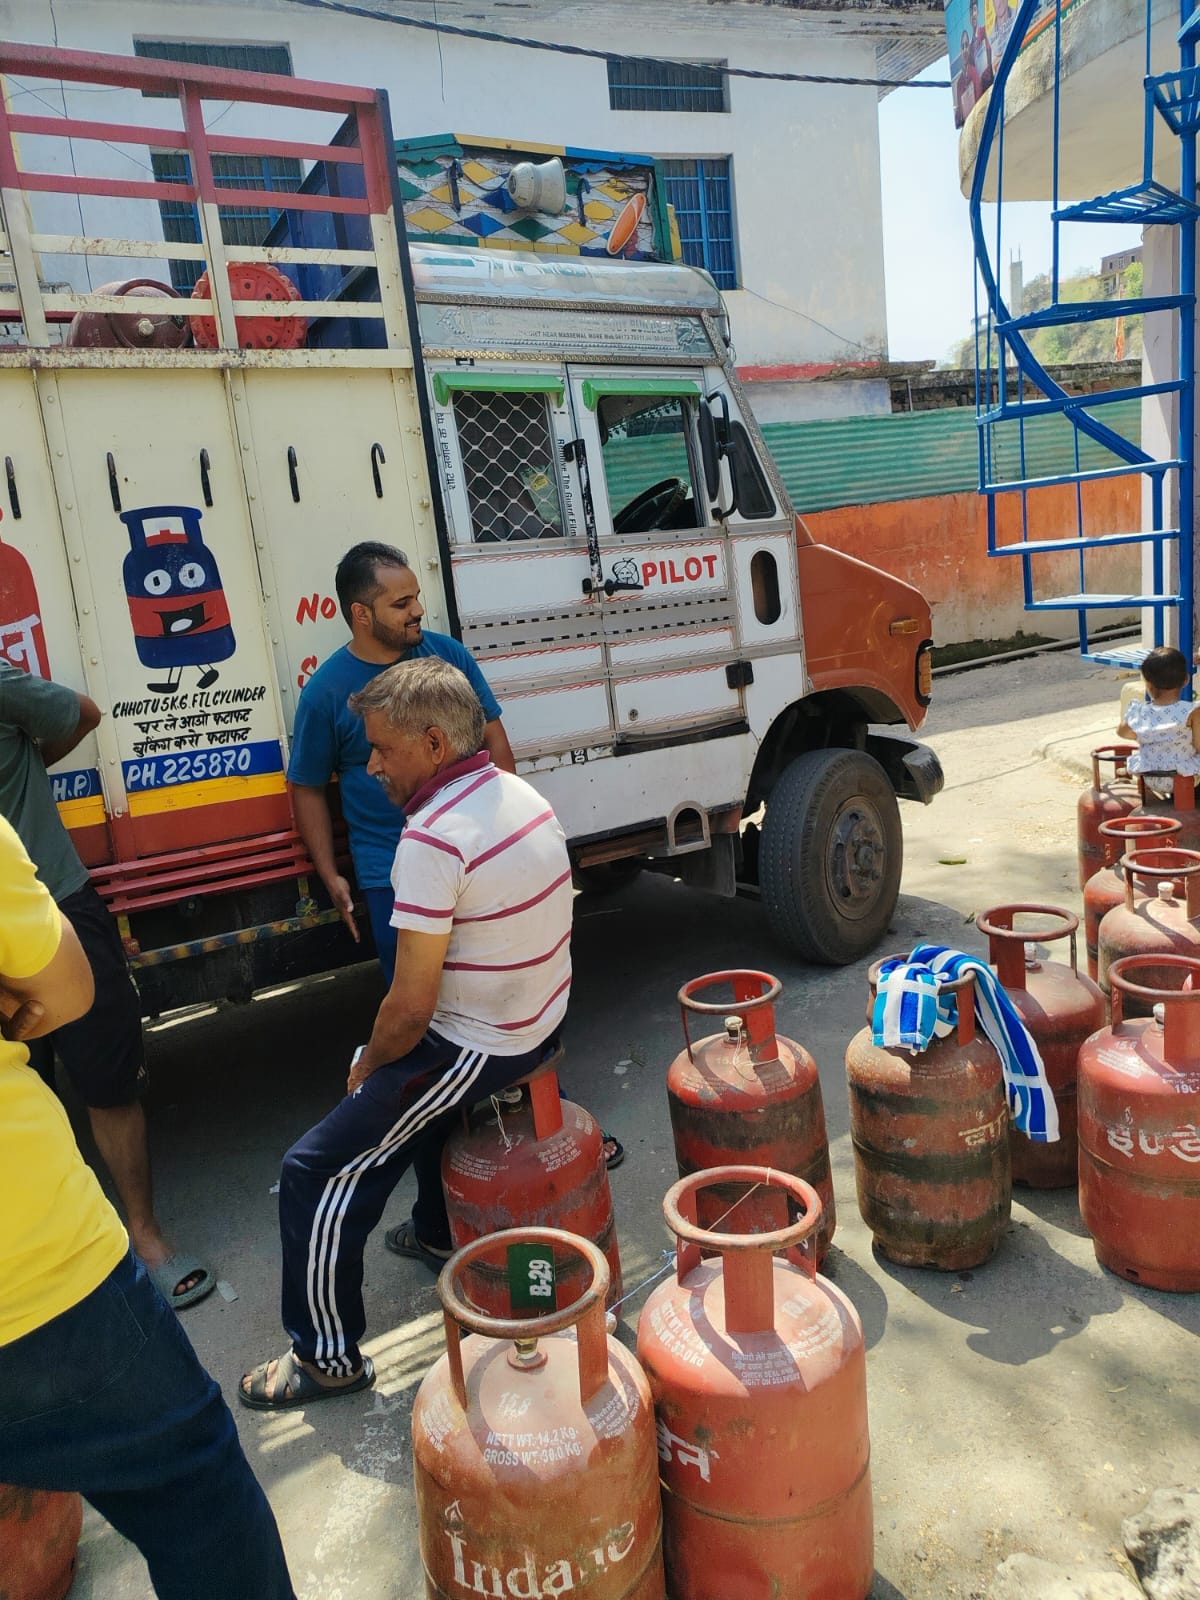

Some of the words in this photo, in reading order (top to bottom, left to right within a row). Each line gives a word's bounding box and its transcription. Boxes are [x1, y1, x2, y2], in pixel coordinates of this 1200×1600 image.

[562, 474, 570, 489] The
[566, 492, 575, 516] Guard
[569, 518, 577, 536] Film
[641, 554, 717, 587] PILOT
[296, 592, 337, 625] NO
[112, 697, 160, 718] CHHOTU
[191, 691, 211, 708] FTL
[212, 686, 266, 706] CYLINDER
[133, 719, 164, 734] घर
[164, 713, 179, 730] ले
[179, 709, 211, 728] आओ
[212, 707, 253, 726] फटाफट
[174, 729, 204, 749] करो
[205, 727, 252, 745] फटाफट
[528, 1259, 553, 1297] B-29
[486, 1431, 514, 1447] NETT
[484, 1447, 519, 1467] GROSS
